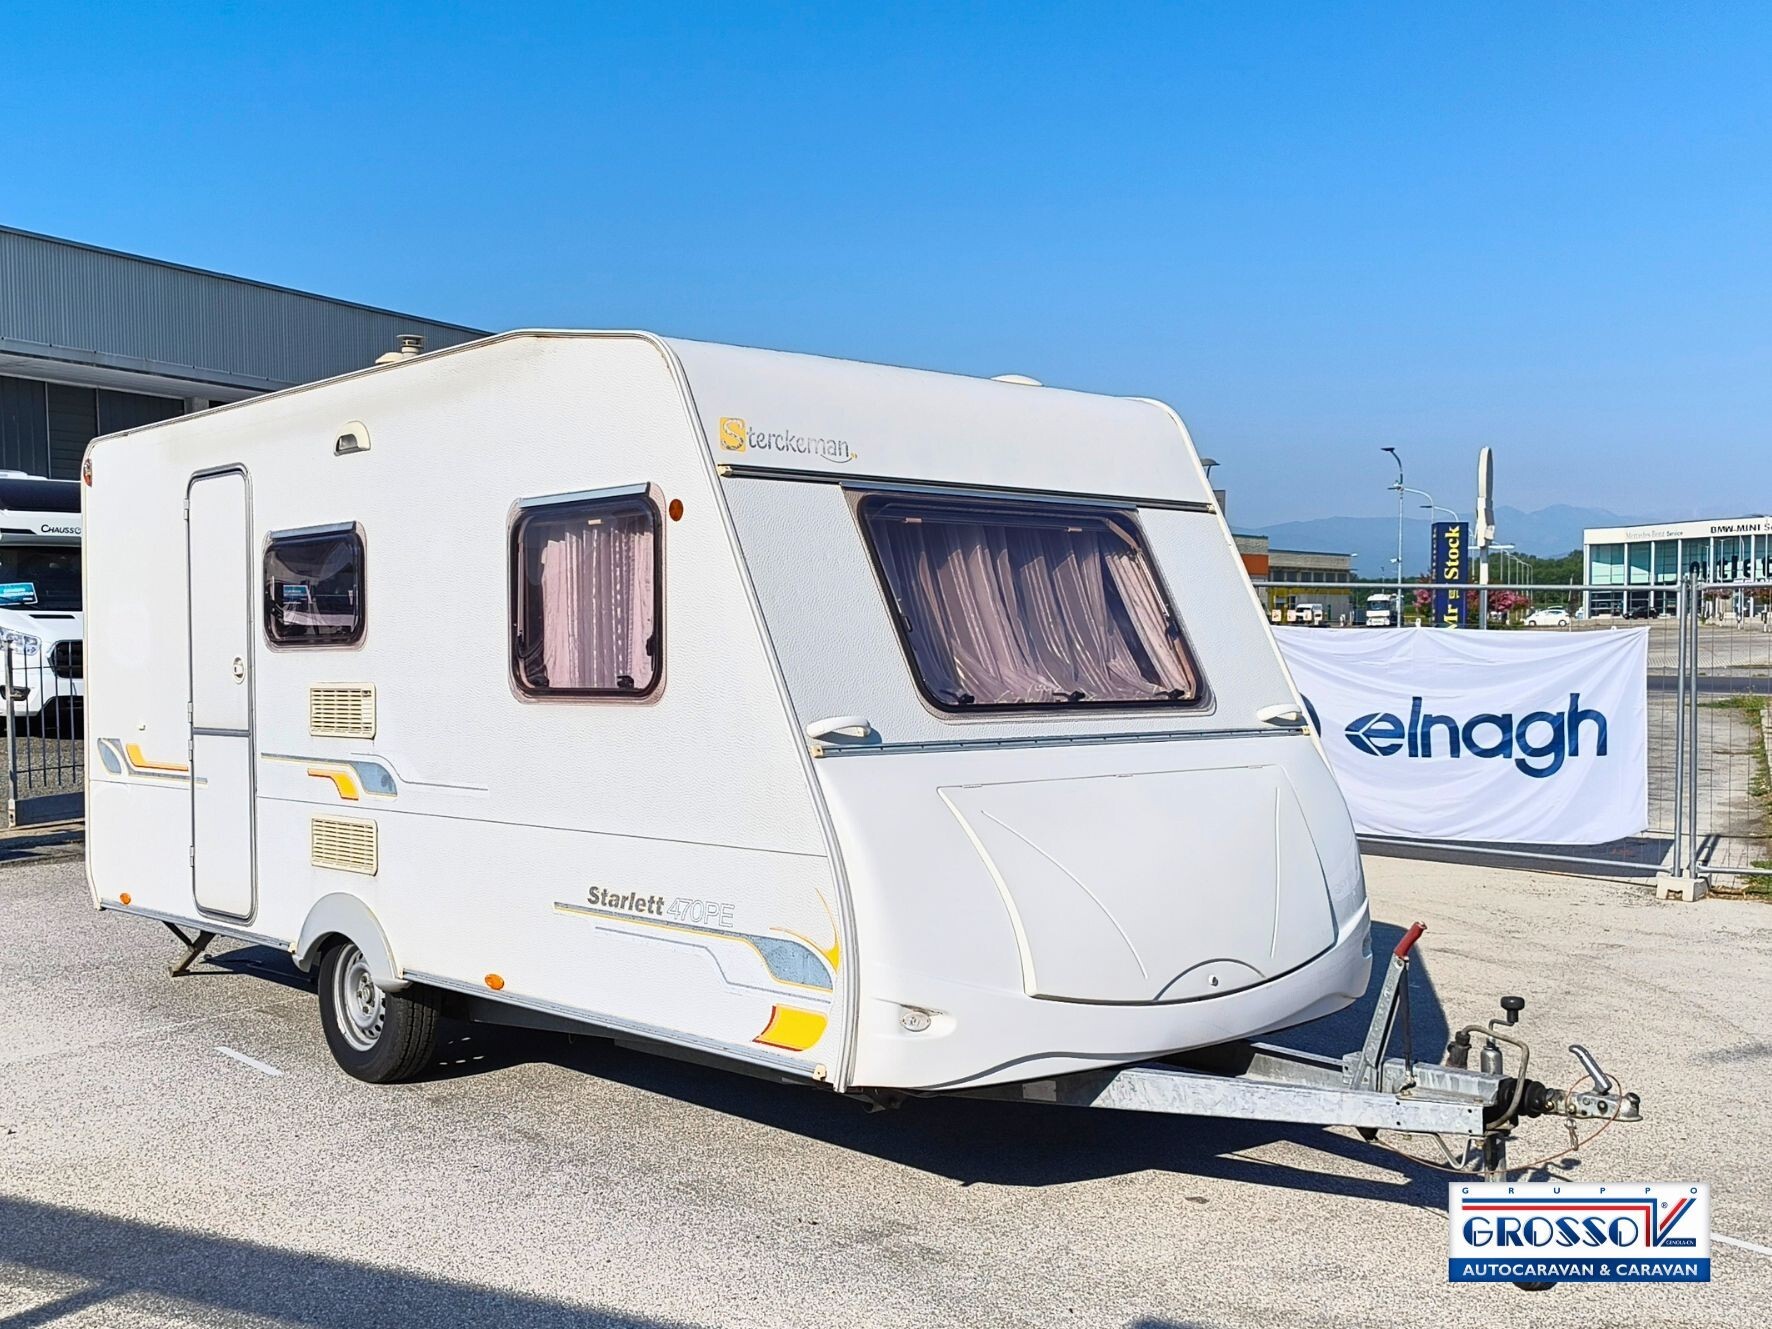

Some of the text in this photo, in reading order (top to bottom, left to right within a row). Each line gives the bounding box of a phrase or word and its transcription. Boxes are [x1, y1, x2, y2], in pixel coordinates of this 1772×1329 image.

[721, 417, 849, 457] Sterckeman
[1444, 525, 1460, 580] Stock
[1344, 692, 1608, 778] elnagh
[587, 886, 736, 928] Starlett 470PE
